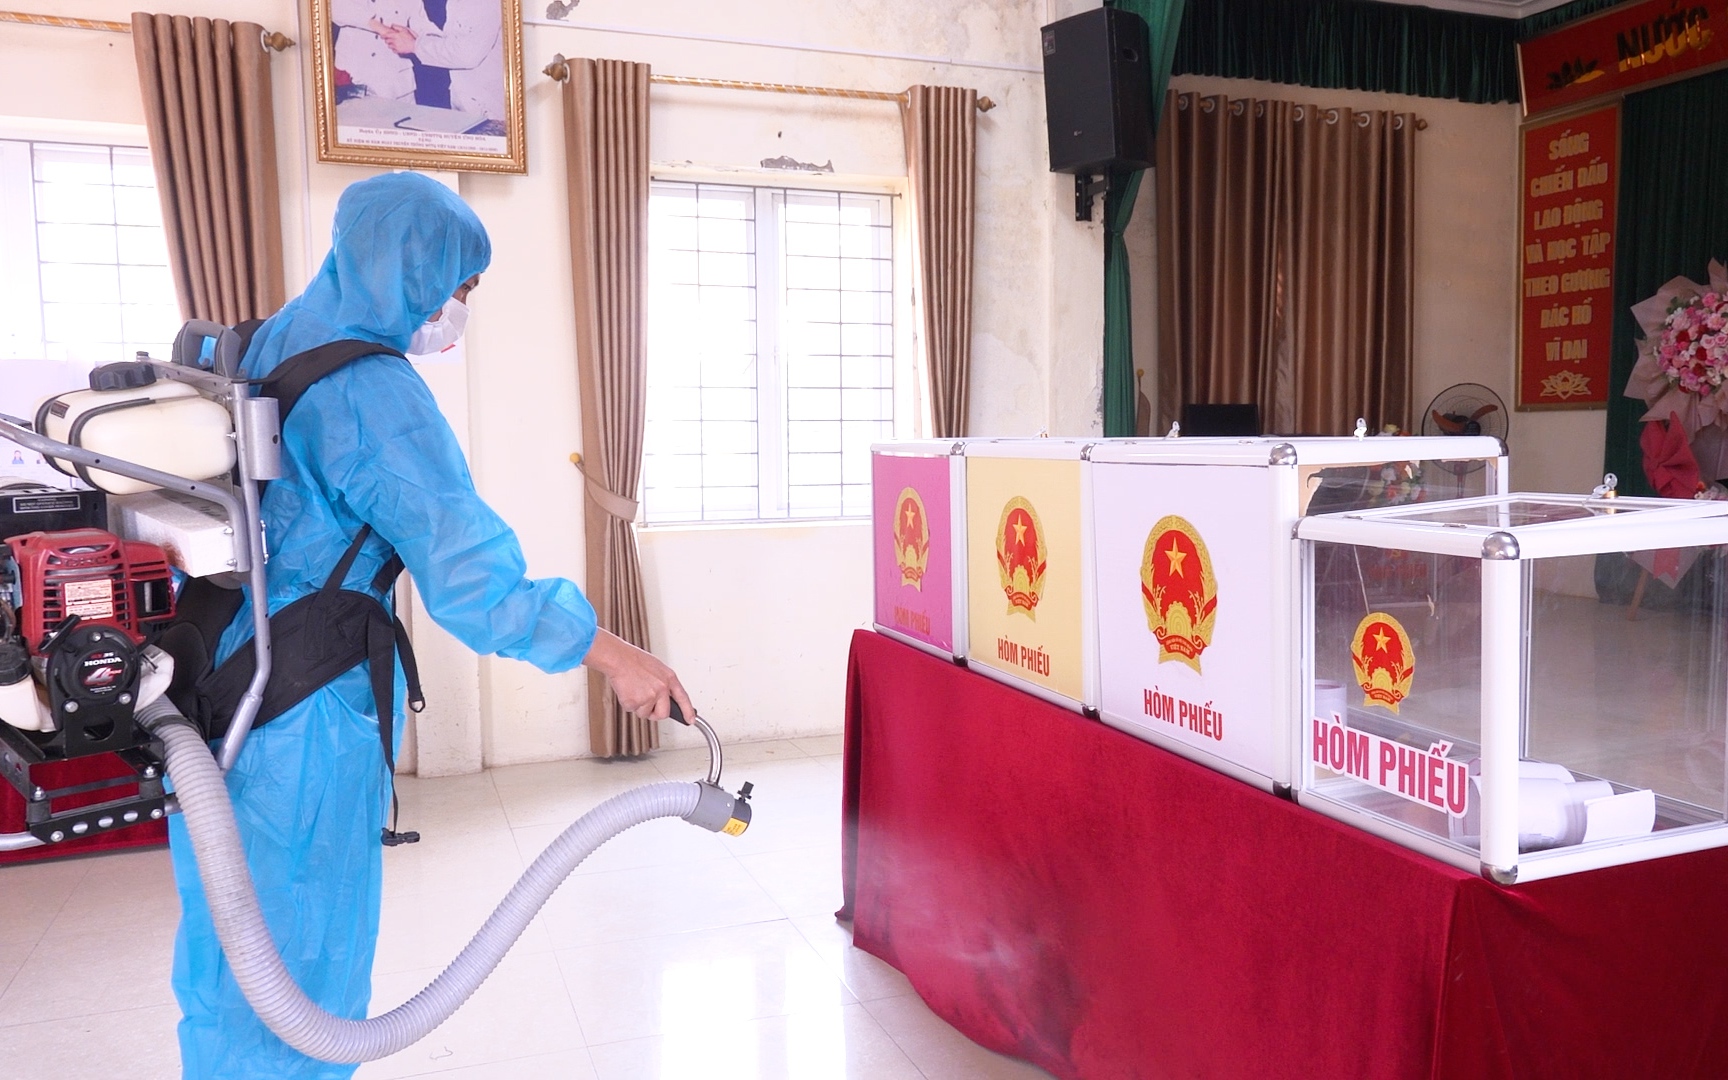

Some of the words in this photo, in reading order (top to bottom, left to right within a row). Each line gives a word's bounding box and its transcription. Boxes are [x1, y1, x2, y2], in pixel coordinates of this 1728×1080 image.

[1616, 0, 1712, 72] NƯỚC
[1548, 129, 1590, 161] SỐNG
[1530, 164, 1574, 198] CHIẾN
[1534, 207, 1562, 231] LAO
[1525, 238, 1544, 264] VÀ
[1547, 238, 1577, 264] HỌC
[1581, 228, 1611, 259] TẬP
[1524, 274, 1559, 298] THEO
[1541, 302, 1570, 329] BÁC
[910, 609, 931, 636] PHIẾU
[84, 657, 123, 667] HONDA
[997, 635, 1018, 665] HÒM
[1021, 645, 1050, 677] PHIẾU
[1143, 685, 1175, 724] HÒM
[1178, 700, 1223, 742] PHIẾU
[1313, 714, 1370, 781] HÒM
[1379, 740, 1466, 814] PHIẾU
